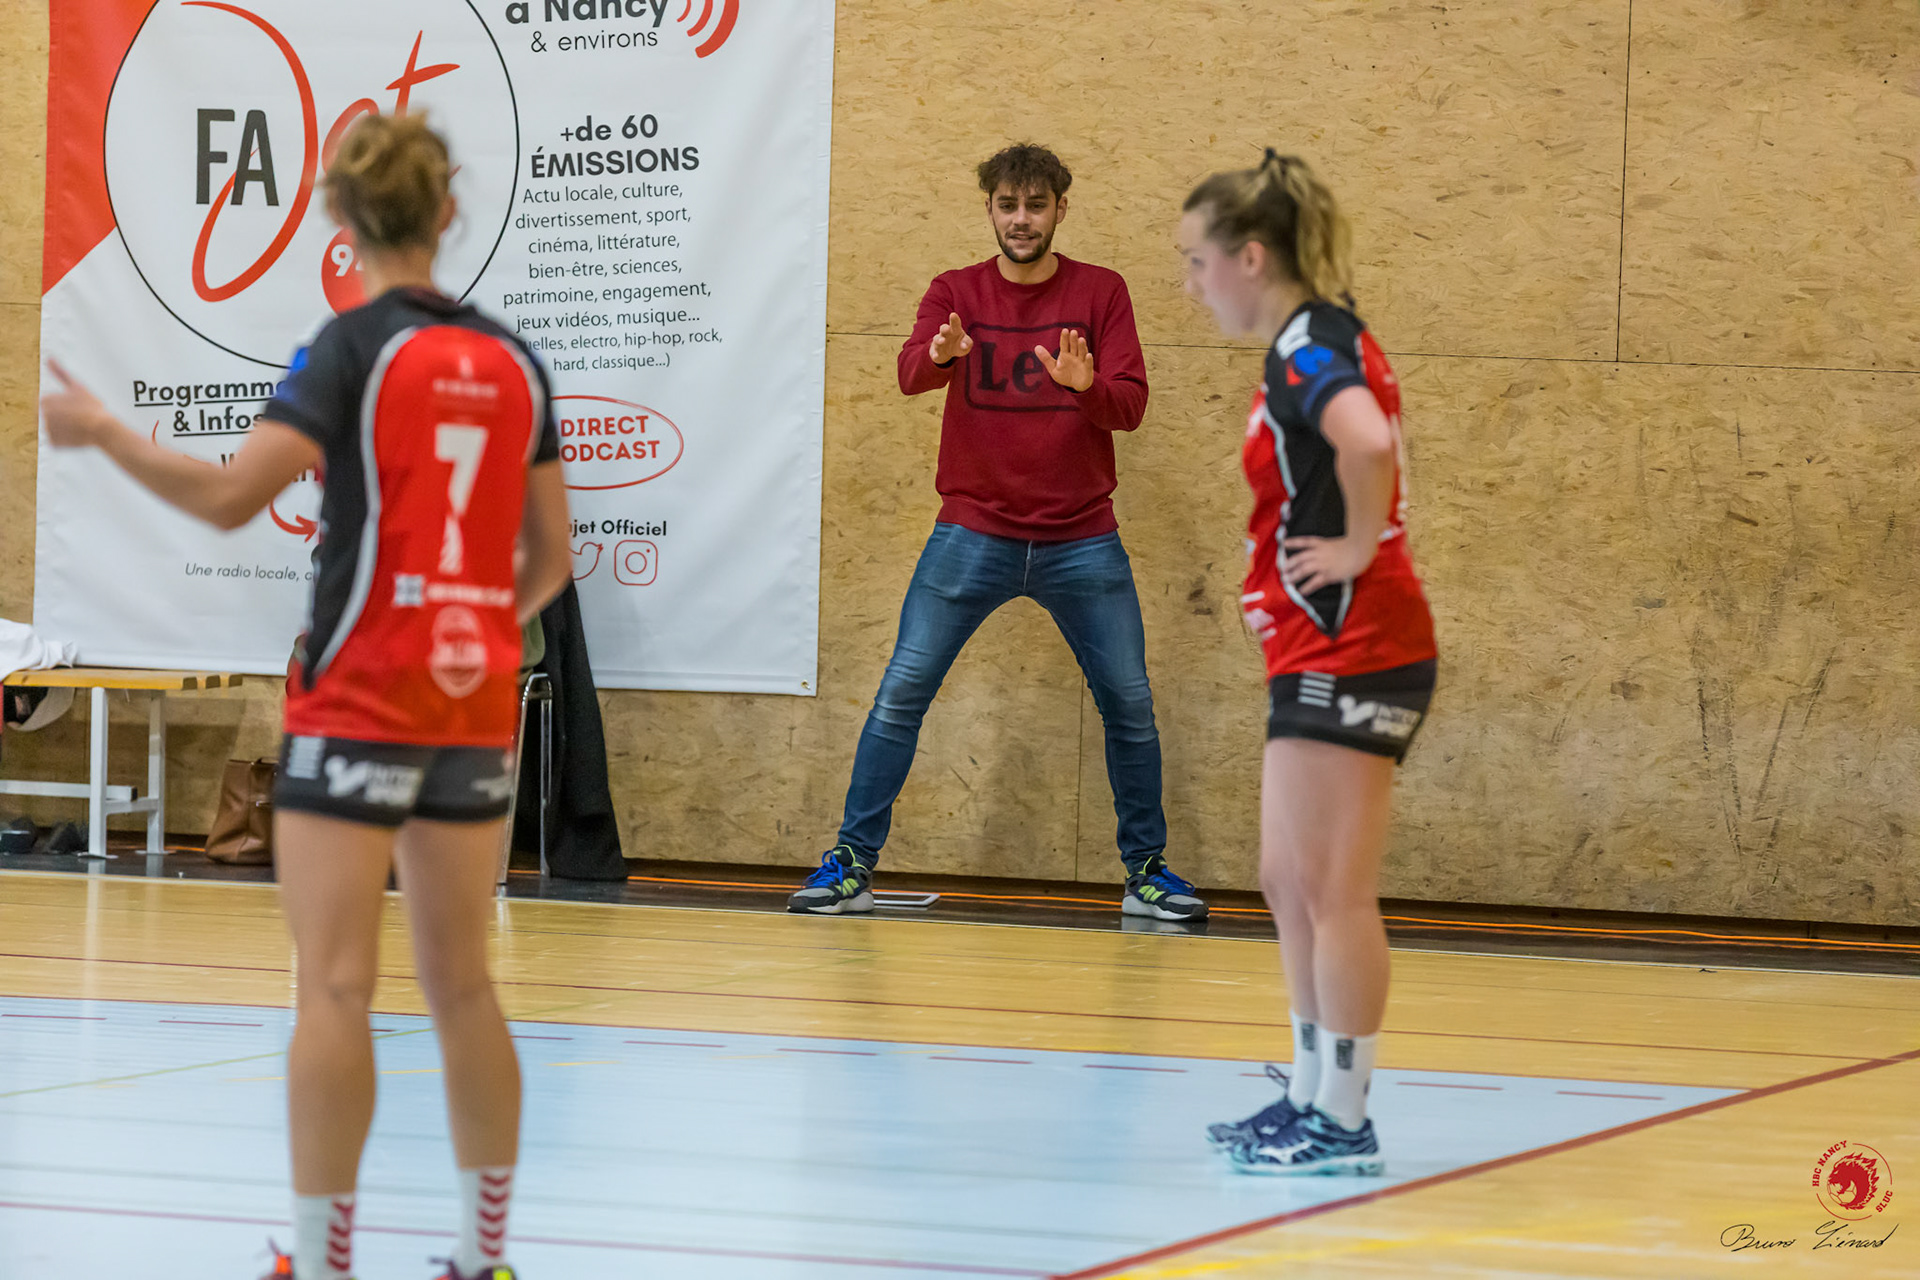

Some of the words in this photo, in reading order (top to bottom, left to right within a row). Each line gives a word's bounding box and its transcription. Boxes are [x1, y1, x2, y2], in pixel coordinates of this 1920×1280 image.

[544, 0, 669, 28] Nancy
[531, 31, 548, 53] &
[558, 30, 659, 51] environs
[621, 113, 659, 140] 60
[531, 146, 700, 179] ÉMISSIONS
[522, 188, 561, 204] Actu
[565, 184, 618, 202] locale,
[622, 182, 683, 199] culture,
[515, 210, 642, 230] divertissement,
[646, 207, 691, 226] sport,
[528, 235, 593, 254] cinéma,
[597, 232, 681, 251] littérature,
[529, 261, 608, 279] bien-être,
[612, 258, 682, 276] sciences,
[503, 286, 598, 309] patrimoine,
[602, 281, 711, 304] engagement,
[516, 315, 551, 334] jeux
[555, 311, 613, 330] vidéos,
[616, 308, 700, 327] musique...
[570, 334, 621, 350] electro,
[624, 331, 685, 348] hip-hop,
[689, 328, 723, 343] rock,
[553, 356, 588, 372] hard,
[591, 352, 671, 371] classique...)
[976, 341, 1061, 394] Le
[173, 410, 191, 432] &
[560, 415, 649, 437] DIRECT
[560, 440, 660, 462] ODCAST
[435, 423, 489, 574] 7
[601, 519, 667, 537] Officiel
[185, 562, 213, 577] Une
[216, 564, 251, 578] radio
[255, 565, 299, 582] locale,
